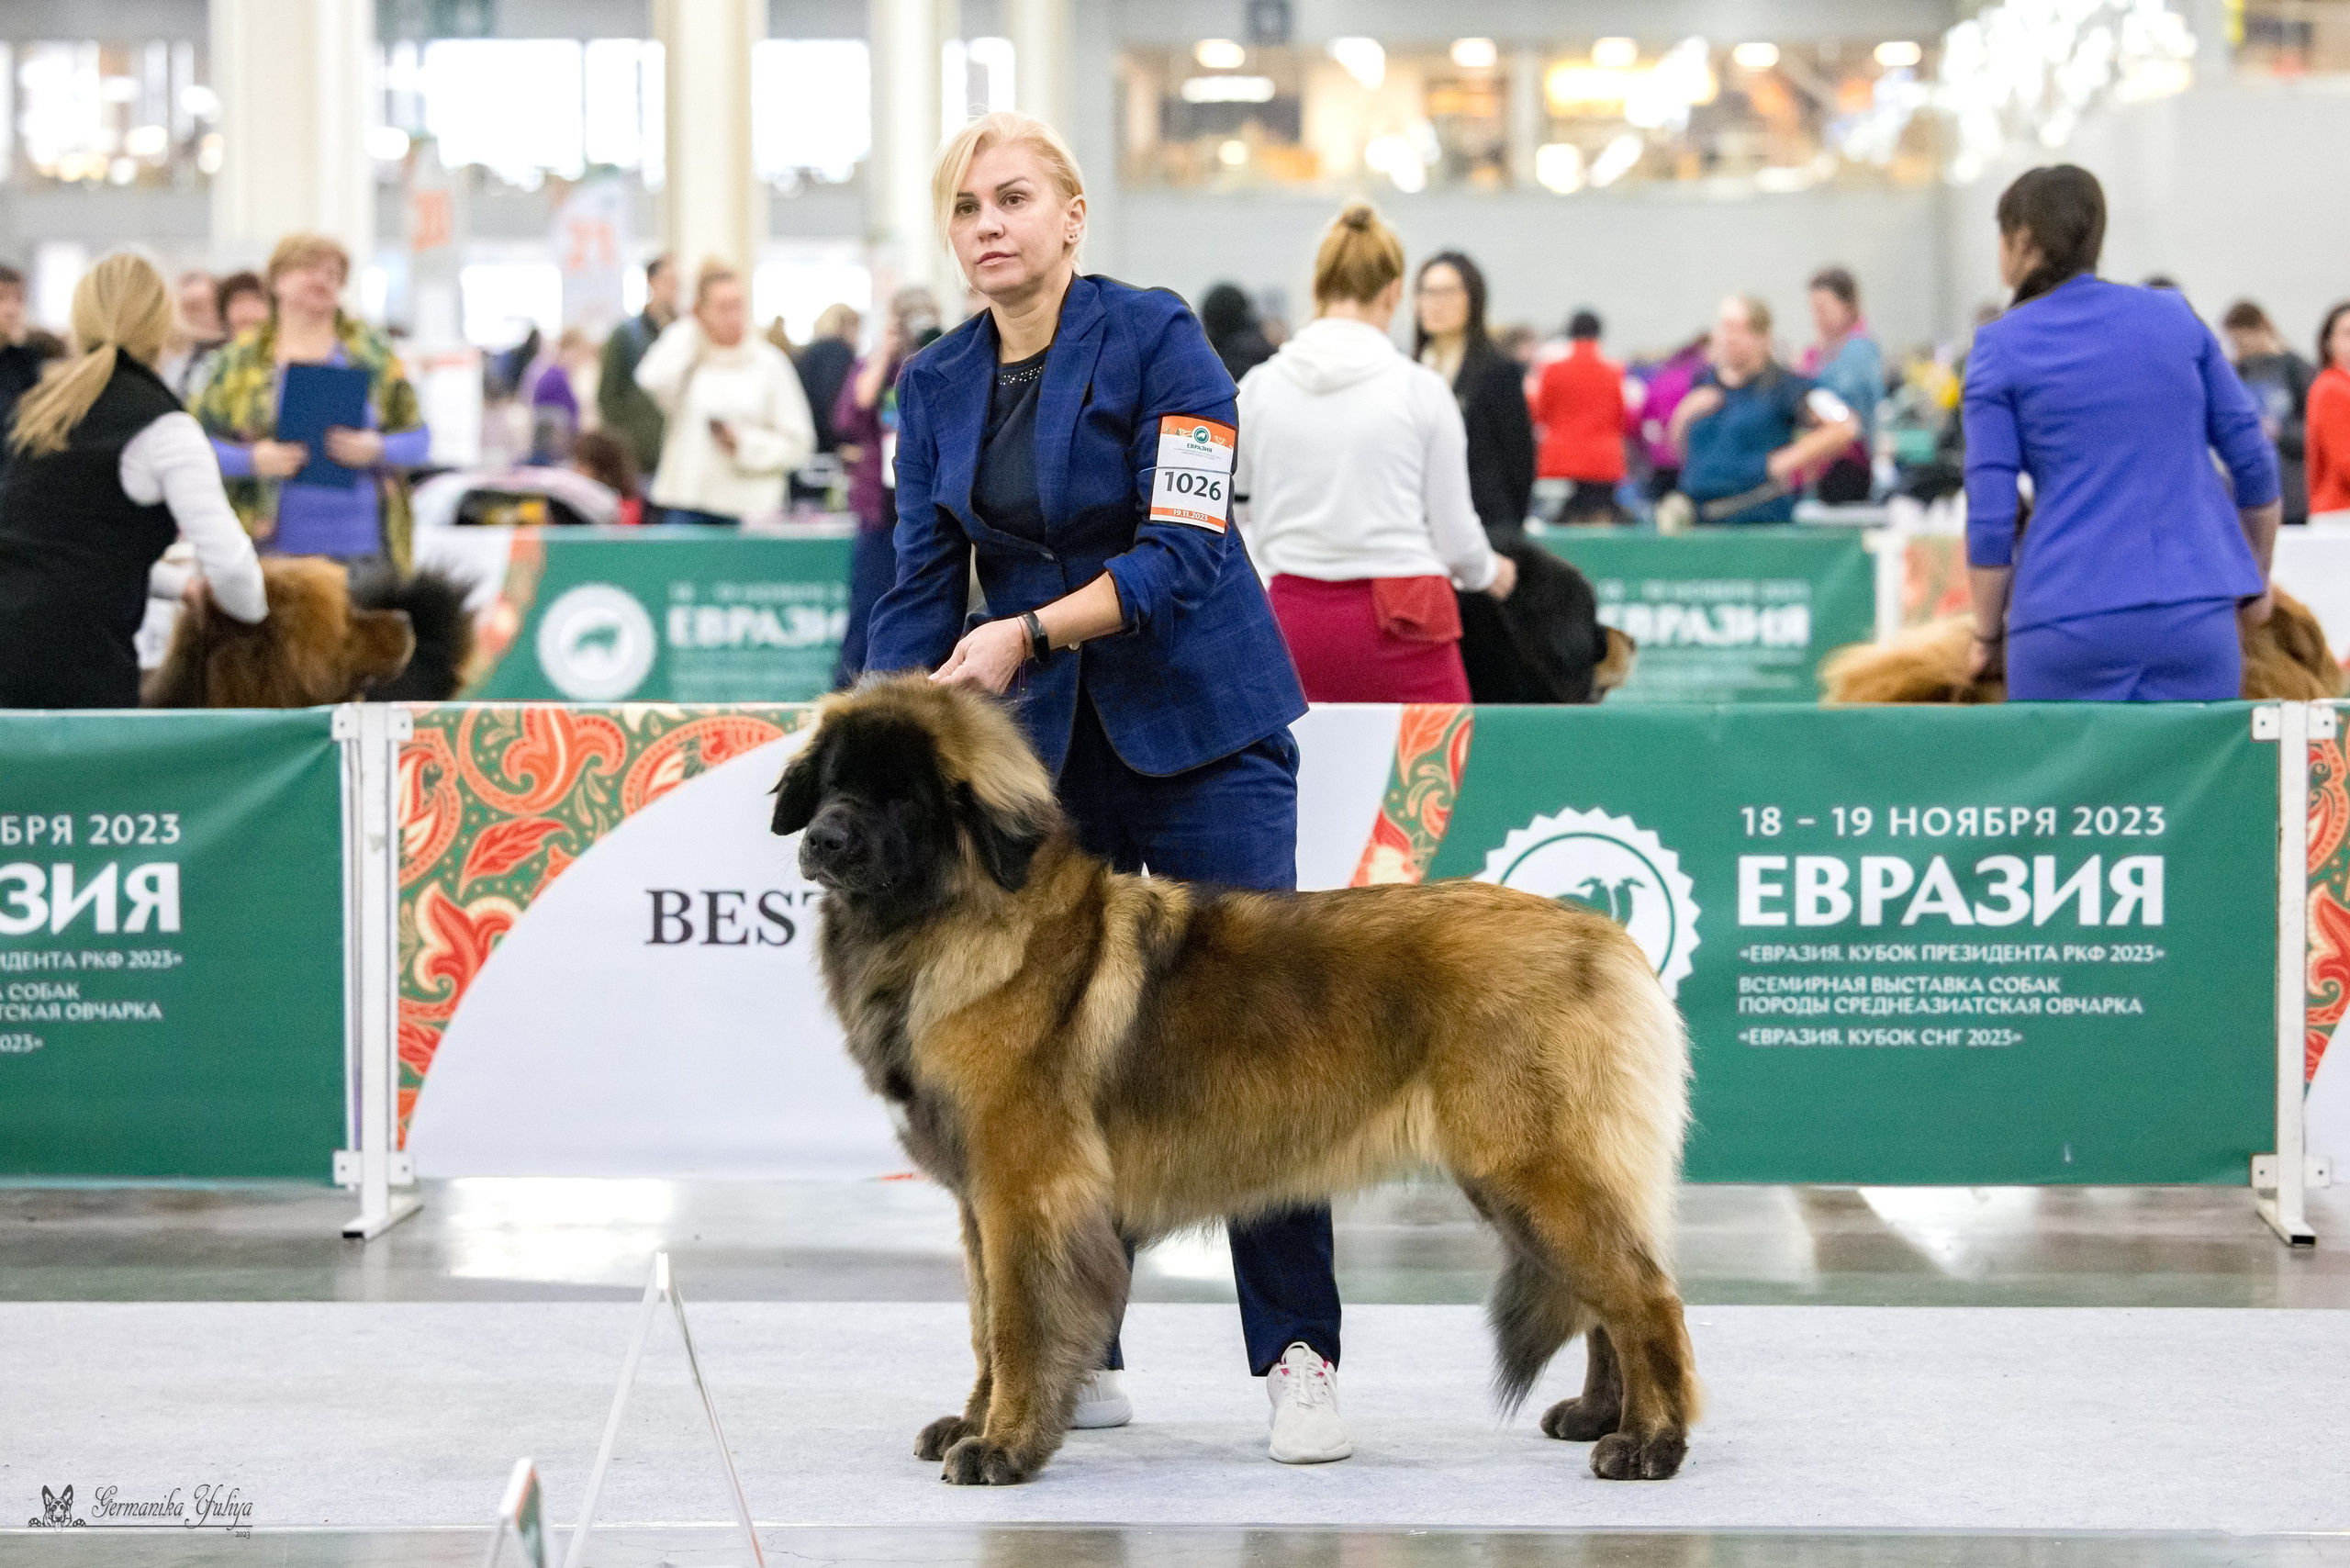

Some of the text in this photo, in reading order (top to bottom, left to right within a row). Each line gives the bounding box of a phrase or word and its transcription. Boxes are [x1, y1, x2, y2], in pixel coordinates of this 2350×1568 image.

[1187, 442, 1213, 454] ЕВРАЗИЯ
[1164, 471, 1222, 501] 1026
[1172, 509, 1208, 521] 19.11.2023
[89, 813, 181, 845] 2023
[1740, 806, 1782, 836] 18
[1831, 806, 1874, 836] 19
[1889, 806, 2056, 836] НОЯБРЯ
[2072, 805, 2165, 835] 2023
[1738, 854, 2165, 927] ЕВРАЗИЯ
[644, 890, 820, 946] BES
[81, 949, 124, 969] РКФ
[1848, 944, 1918, 963] КУБОК
[1921, 944, 2060, 965] ПРЕЗИДЕНТА
[2064, 944, 2107, 963] РКФ
[2109, 944, 2166, 963] 2023»
[7, 981, 81, 1002] СОБАК
[1739, 975, 2061, 994] ВСЕМИРНАЯ ВЫСТАВКА СОБАК
[65, 1001, 163, 1021] ОВЧАРКА
[1739, 995, 2143, 1017] ПОРОДЫ СРЕДНЕАЗИАТСКАЯ ОВЧАРКА
[1847, 1026, 1917, 1047] КУБОК
[1920, 1026, 1963, 1047] СНГ
[1967, 1027, 2023, 1047] 2023»
